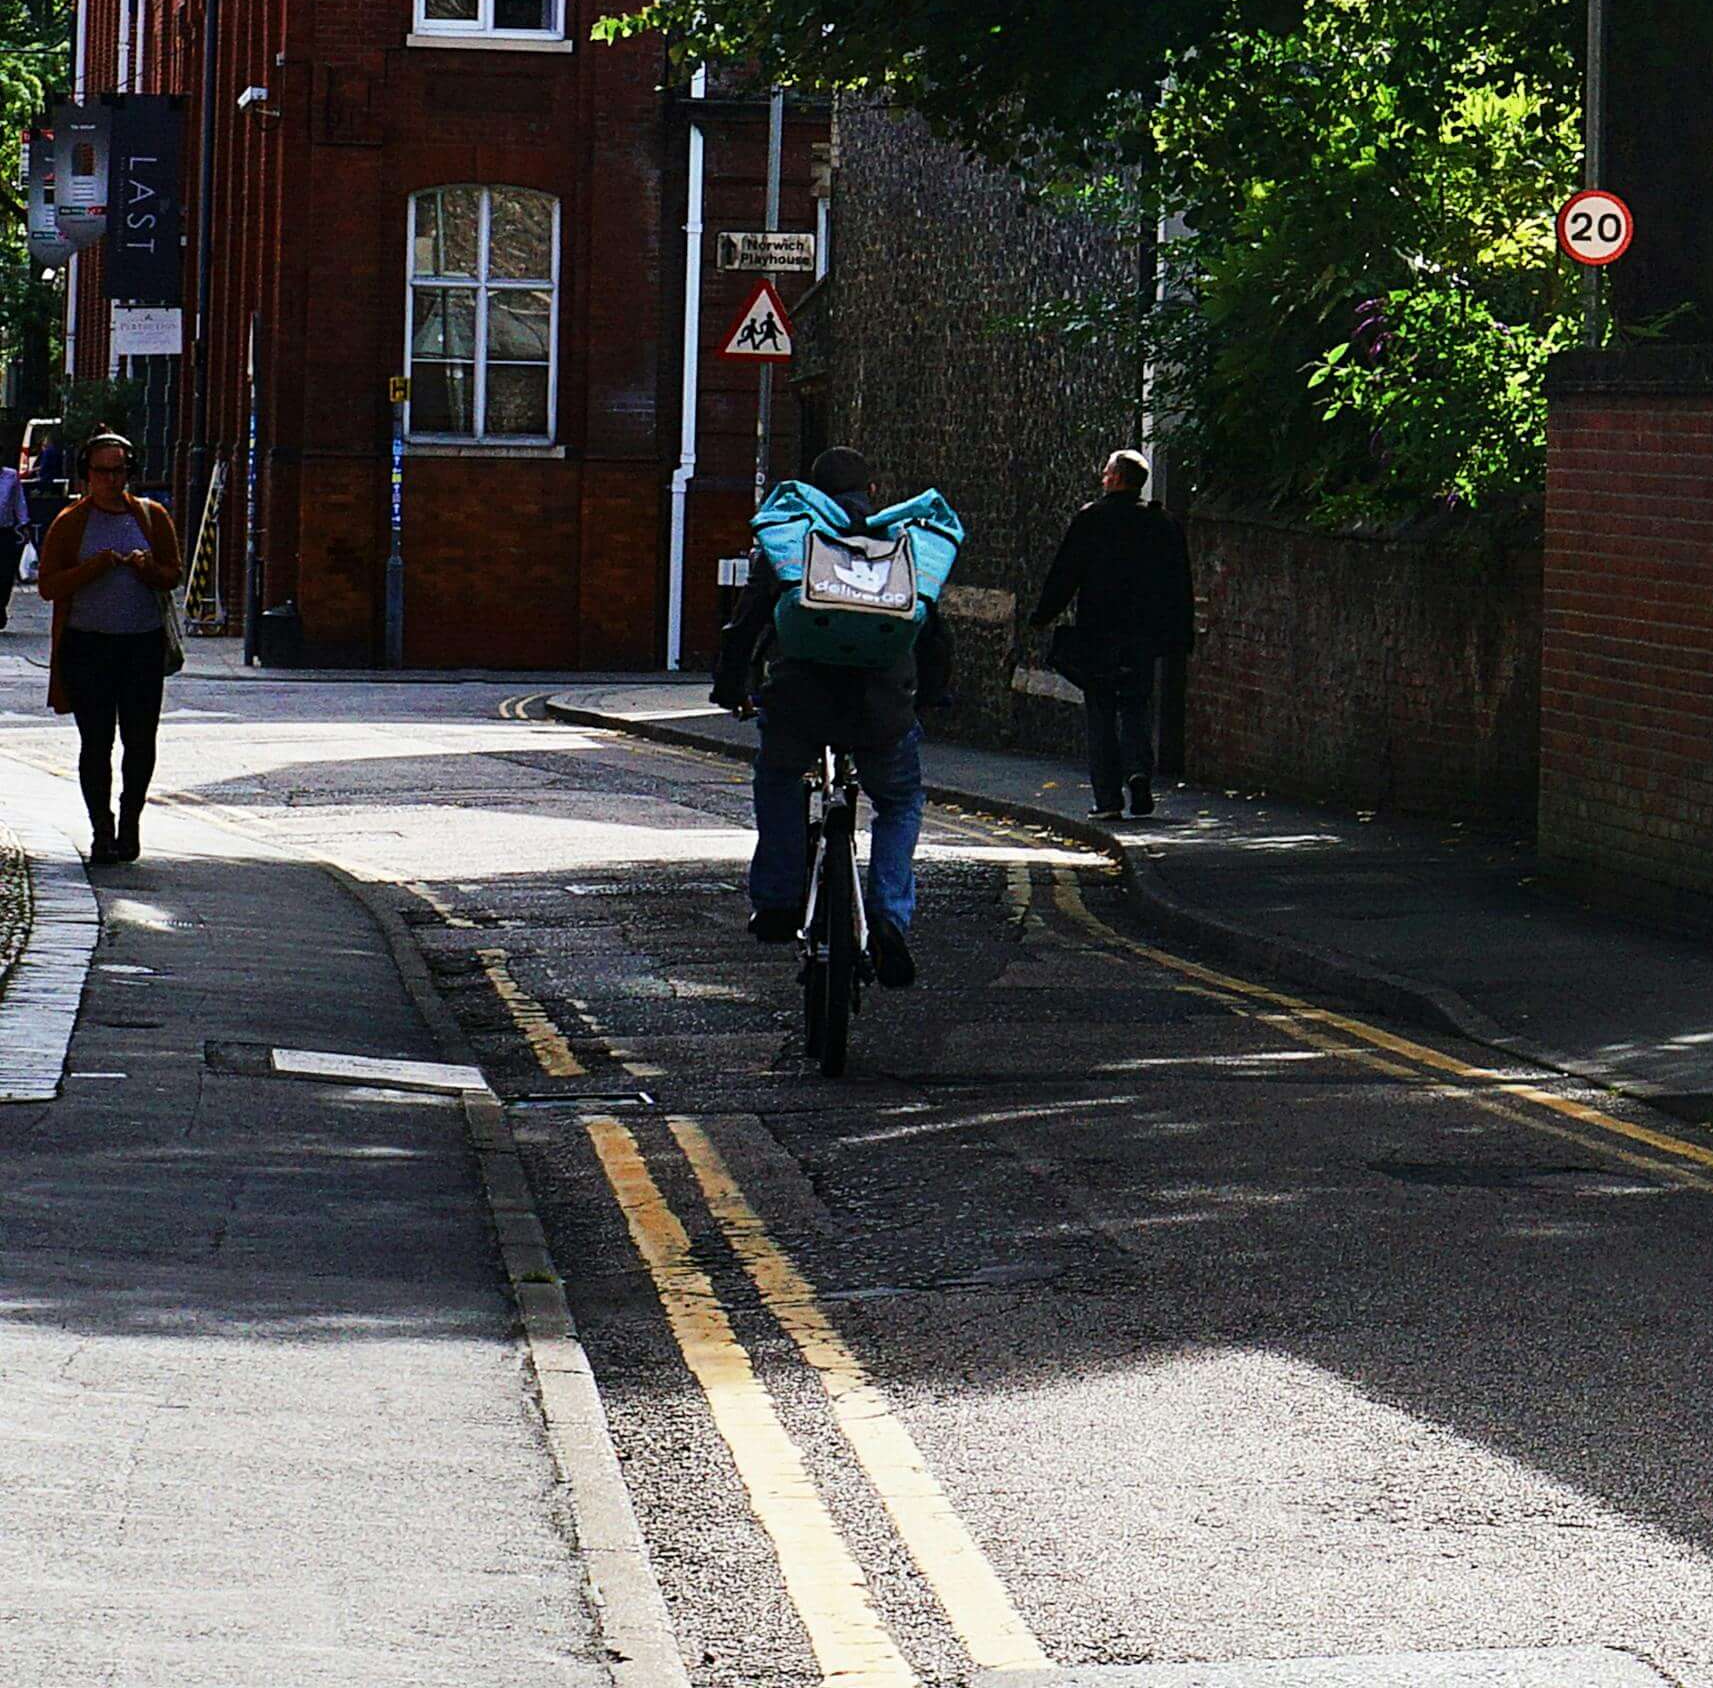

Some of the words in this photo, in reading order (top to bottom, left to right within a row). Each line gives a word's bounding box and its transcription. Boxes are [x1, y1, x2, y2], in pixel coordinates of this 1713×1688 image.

[127, 157, 157, 253] LAST
[1571, 212, 1622, 243] 20
[747, 238, 804, 252] Norwich
[740, 252, 810, 268] Playhouse
[393, 379, 407, 399] H
